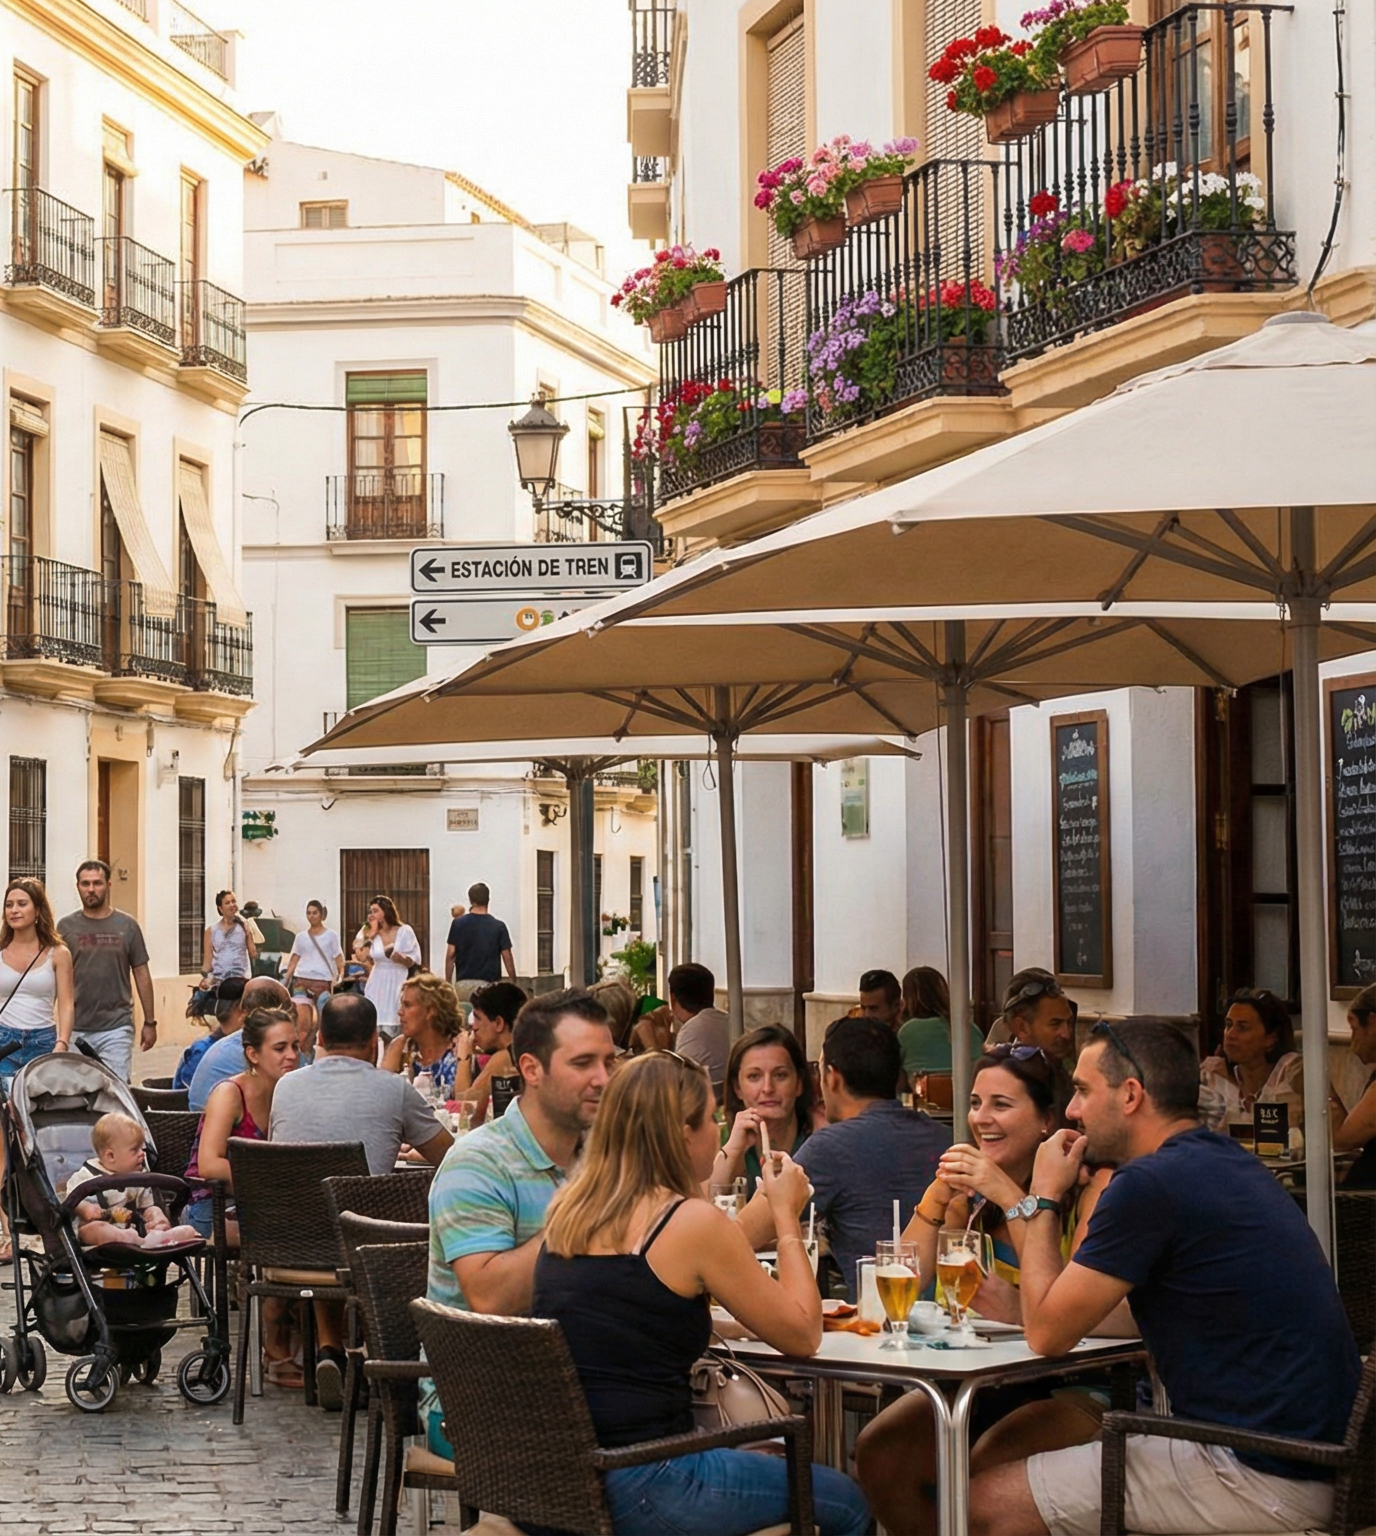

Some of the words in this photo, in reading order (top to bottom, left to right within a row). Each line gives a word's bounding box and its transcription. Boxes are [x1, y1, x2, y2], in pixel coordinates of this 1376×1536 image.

[451, 556, 532, 579] ESTACIÓN
[538, 559, 560, 576] DE
[565, 557, 609, 575] TREN
